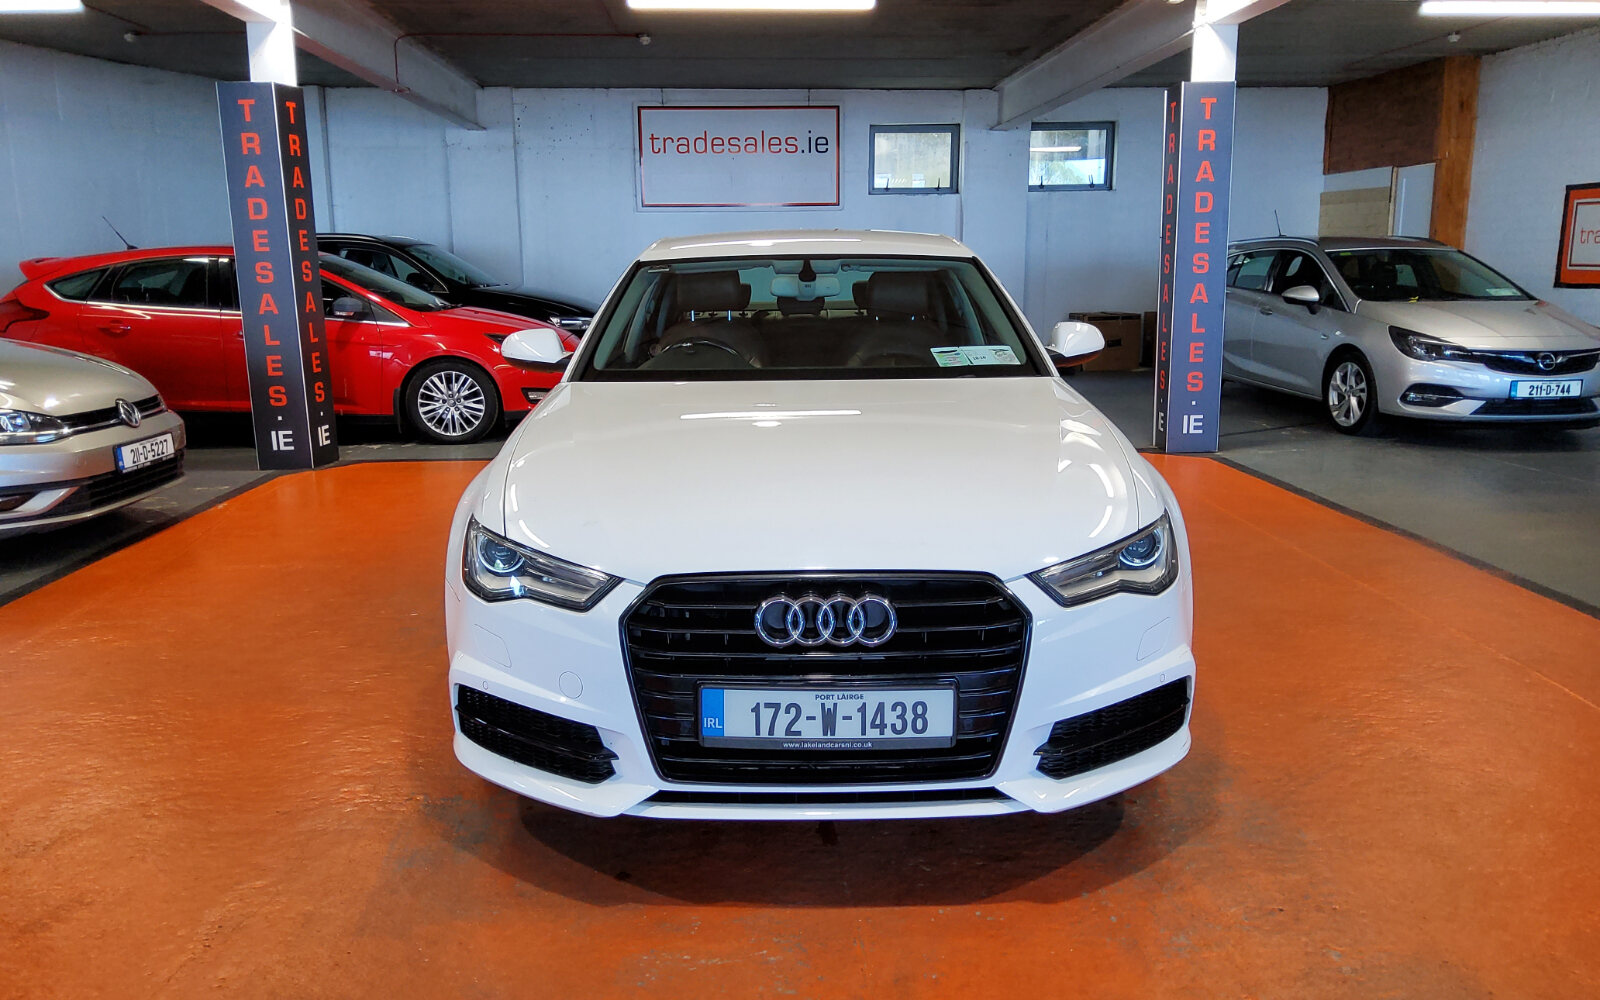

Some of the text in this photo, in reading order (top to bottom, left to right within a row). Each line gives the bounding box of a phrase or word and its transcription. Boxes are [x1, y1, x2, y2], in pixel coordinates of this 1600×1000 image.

[649, 130, 829, 154] tradesales.ie
[1528, 383, 1571, 396] 211-D-744
[130, 439, 169, 464] 211-D-5227
[815, 693, 835, 701] PORT
[703, 717, 723, 729] IRL
[750, 701, 929, 737] 172-W-1438
